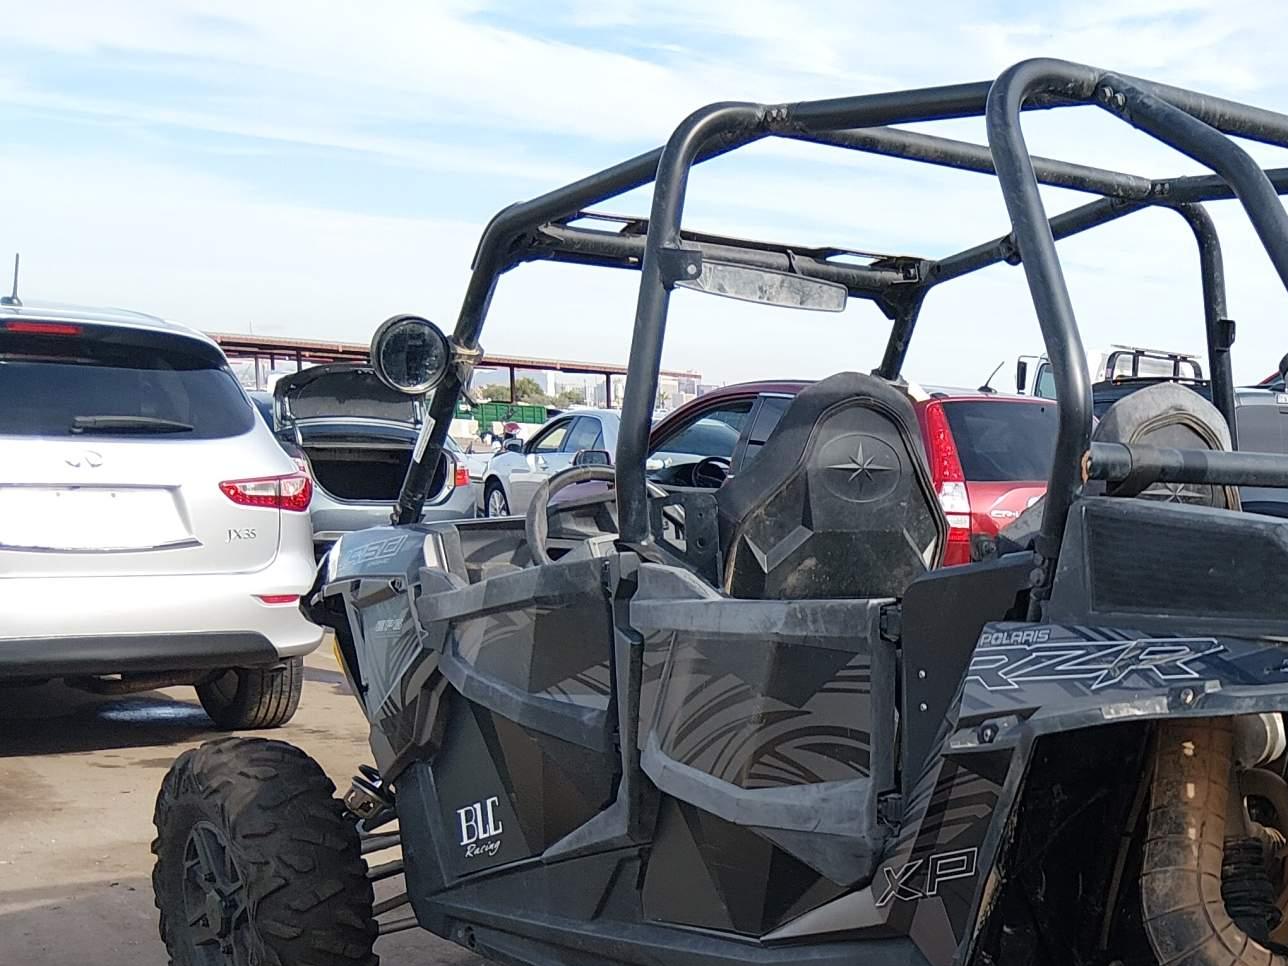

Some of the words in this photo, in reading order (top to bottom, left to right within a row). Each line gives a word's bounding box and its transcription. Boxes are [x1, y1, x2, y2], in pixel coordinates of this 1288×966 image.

[225, 528, 257, 544] JX35
[980, 629, 1050, 646] POLARIS
[965, 637, 1225, 691] RZR
[456, 796, 503, 846] BLC
[464, 840, 501, 858] Racing
[874, 847, 978, 907] XP
